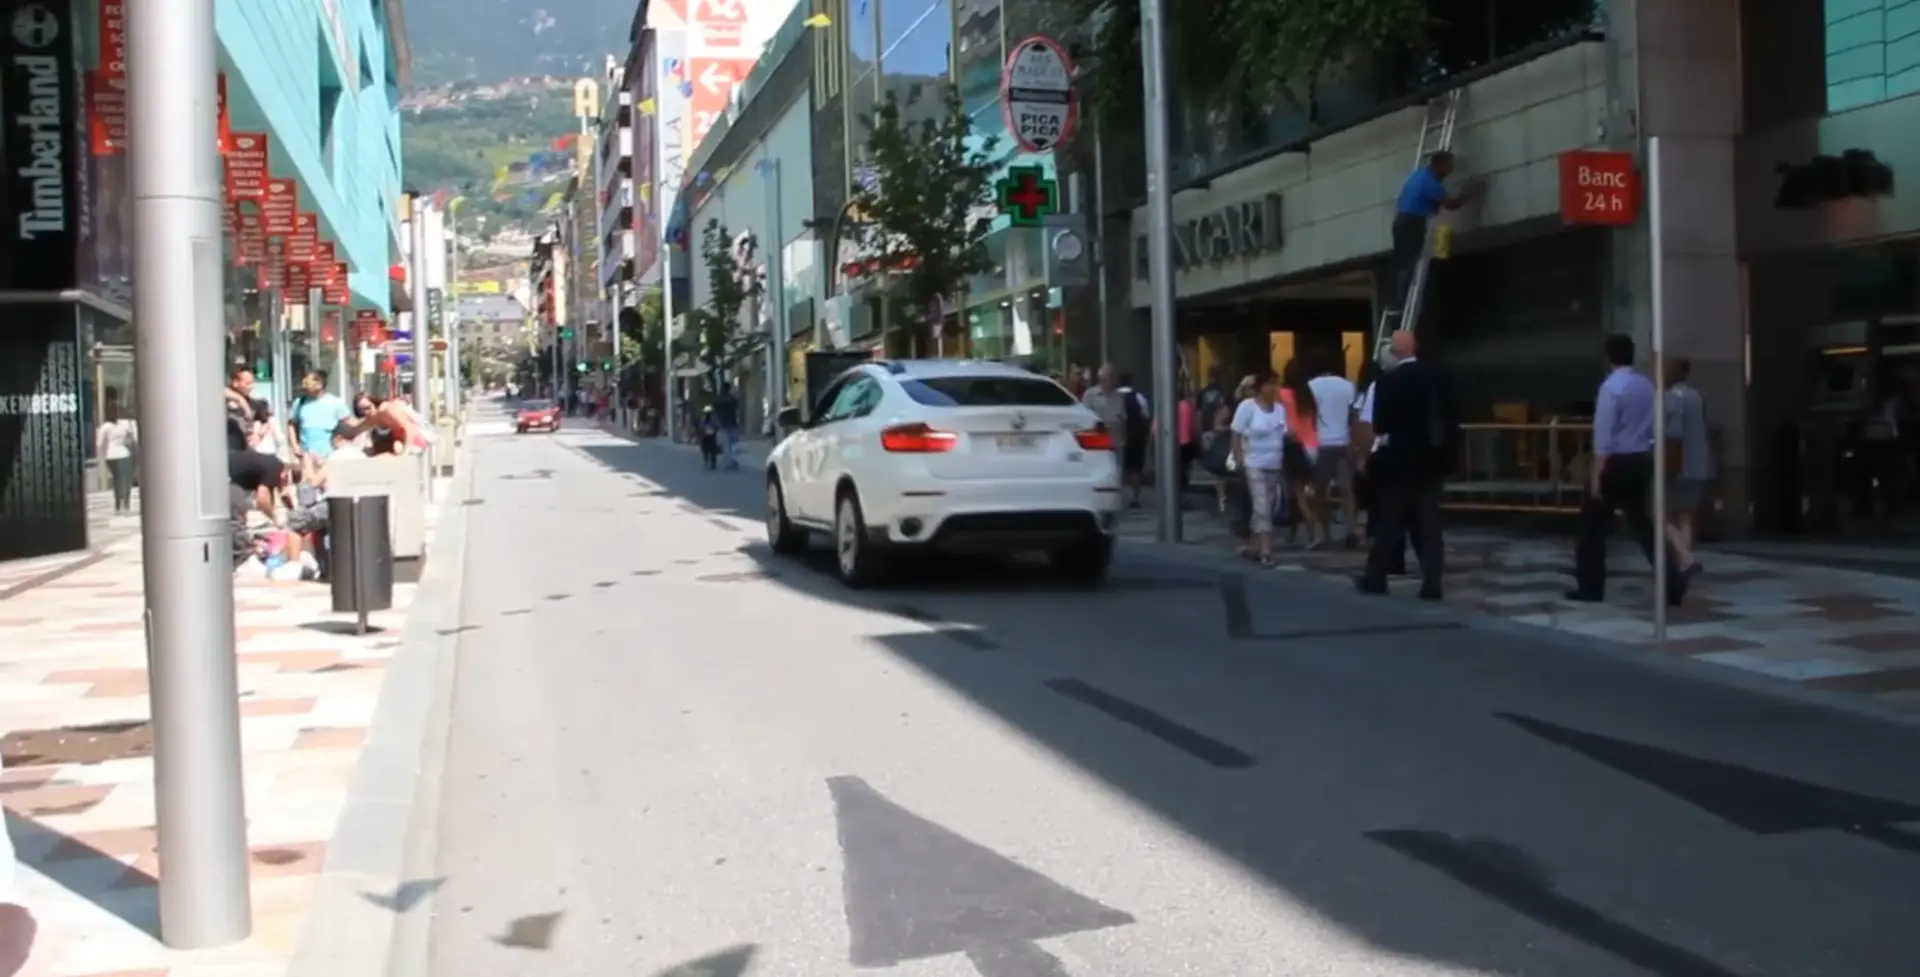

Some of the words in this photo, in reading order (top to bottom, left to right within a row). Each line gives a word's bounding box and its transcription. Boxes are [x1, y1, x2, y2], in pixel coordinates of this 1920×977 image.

[1021, 114, 1060, 126] PICA
[1021, 125, 1060, 137] PICA
[14, 54, 63, 239] Timberland
[1577, 165, 1627, 189] Banc
[1584, 191, 1608, 213] 24
[1611, 193, 1624, 212] h
